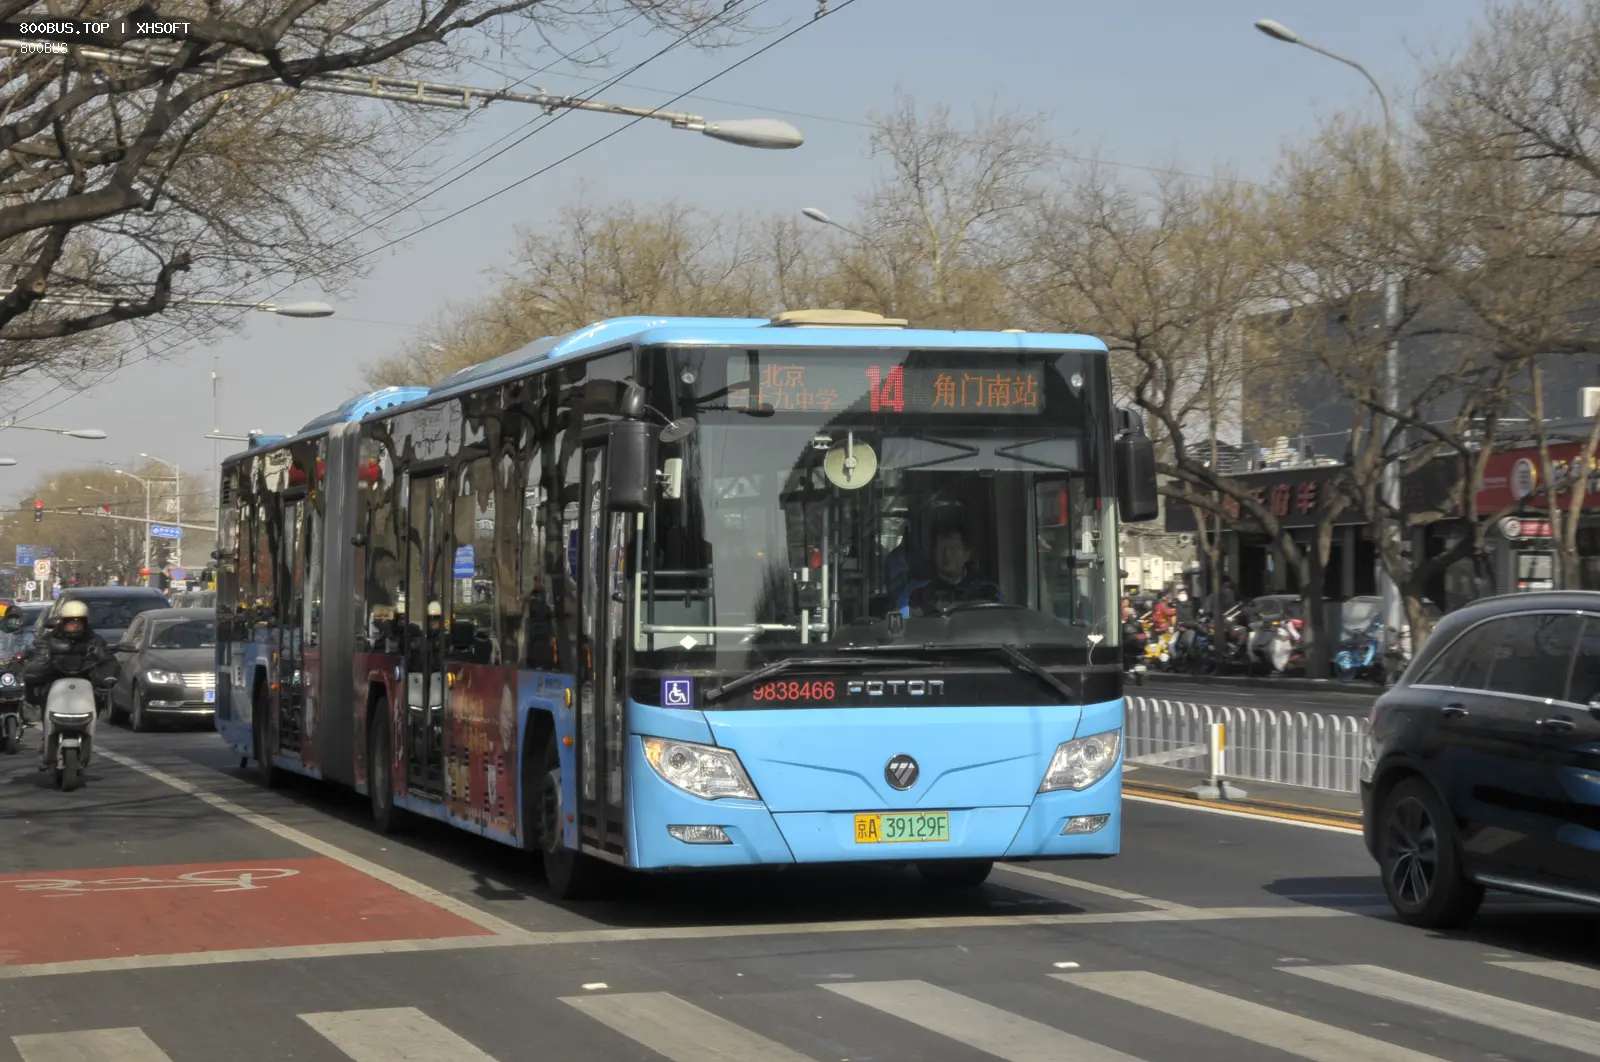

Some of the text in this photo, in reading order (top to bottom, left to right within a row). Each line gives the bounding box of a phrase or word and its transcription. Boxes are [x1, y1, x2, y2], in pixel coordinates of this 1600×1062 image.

[760, 363, 806, 388] 北京
[865, 365, 905, 412] 14
[932, 372, 1039, 408] 角门南站
[752, 681, 835, 701] 9838466
[846, 680, 945, 697] FOTON
